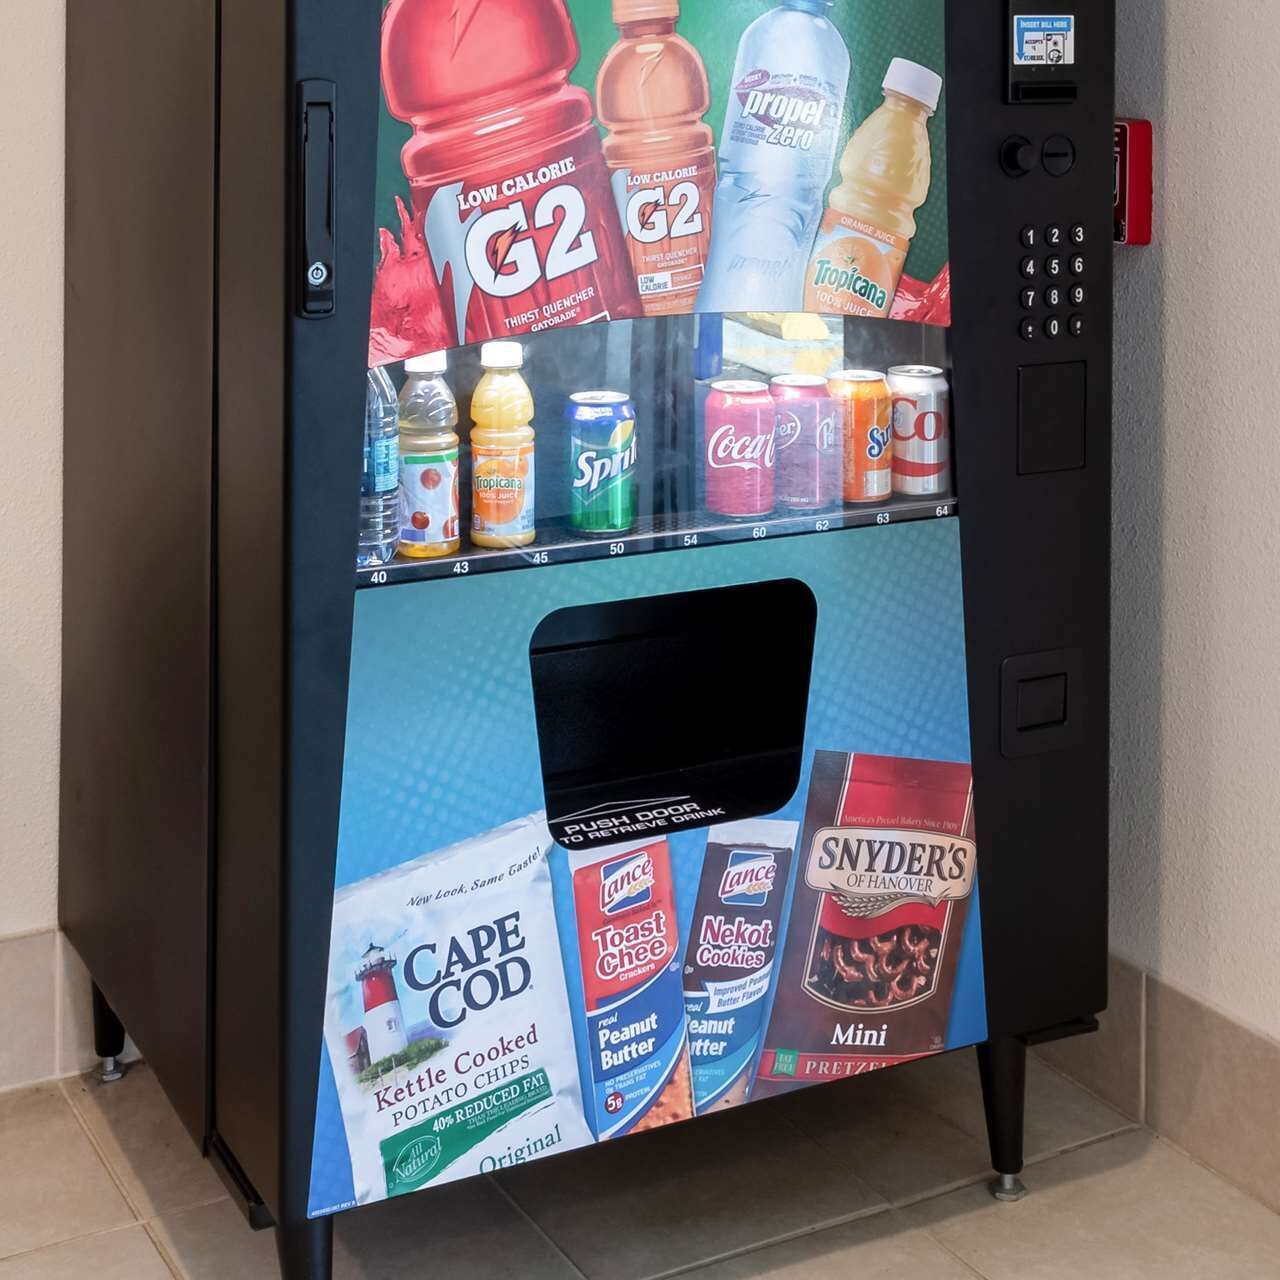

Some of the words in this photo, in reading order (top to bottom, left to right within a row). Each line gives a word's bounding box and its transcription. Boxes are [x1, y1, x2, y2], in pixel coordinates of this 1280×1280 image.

[742, 89, 826, 126] propel
[766, 124, 814, 151] zero
[457, 185, 499, 211] LOW
[501, 157, 576, 198] CALORIE
[627, 175, 651, 186] LOW
[652, 166, 698, 183] CALORIE
[626, 181, 704, 245] G2
[465, 184, 599, 298] G2
[840, 216, 874, 235] ORANGE
[874, 229, 897, 245] JUICE
[1027, 229, 1035, 245] 1
[1051, 228, 1060, 243] 2
[1075, 227, 1084, 242] 3
[641, 253, 664, 264] THIRST
[664, 247, 697, 261] QUENCHER
[1026, 259, 1035, 275] 4
[1051, 259, 1059, 274] 5
[1074, 257, 1083, 273] 6
[640, 275, 655, 284] LOW
[640, 281, 670, 293] CALORIE
[813, 259, 887, 310] Tropicana
[504, 308, 540, 329] THIRST
[542, 286, 596, 318] QUENCHER
[815, 290, 842, 309] 100%
[843, 299, 873, 317] JUICE
[1027, 291, 1035, 306] 7
[1051, 289, 1059, 305] 8
[1075, 287, 1084, 303] 9
[1050, 320, 1058, 335] 0
[476, 475, 522, 490] Tropicana
[877, 513, 890, 523] 63
[935, 506, 948, 516] 64
[753, 527, 766, 538] 60
[815, 520, 829, 531] 62
[610, 543, 624, 555] 50
[684, 534, 698, 545] 54
[453, 561, 469, 573] 43
[533, 552, 548, 564] 45
[370, 571, 387, 583] 40
[560, 833, 583, 844] TO
[588, 818, 668, 840] RETRIEVE
[671, 807, 726, 824] DRINK
[564, 815, 629, 835] PUSH
[634, 802, 700, 822] DOOR
[818, 836, 968, 882] SNYDER'S
[406, 893, 433, 907] New
[434, 883, 468, 901] Look,
[470, 872, 505, 891] Same
[601, 858, 651, 910] Lance
[720, 863, 776, 896] Lance
[846, 873, 867, 888] OF
[867, 874, 933, 893] HANOVER
[592, 910, 666, 953] Toast
[700, 915, 772, 948] Nekot
[403, 911, 526, 991] CAPE
[596, 939, 667, 980] Chee
[696, 943, 766, 969] Cookies
[619, 963, 656, 981] Crackers
[428, 956, 532, 1030] COD
[597, 1012, 618, 1029] real
[598, 1012, 658, 1050] Peanut
[830, 1023, 888, 1047] Mini
[600, 1037, 656, 1071] Butter
[774, 1062, 795, 1071] FREE
[779, 1054, 792, 1062] FAT
[374, 1067, 447, 1112] Kettle
[454, 1023, 539, 1075] Cooked
[604, 1077, 615, 1087] NO
[615, 1060, 662, 1084] PRESERVATIVES
[392, 1082, 468, 1127] POTATO
[473, 1054, 531, 1090] CHIPS
[614, 1077, 635, 1091] TRANS
[635, 1073, 647, 1083] FAT
[432, 1115, 455, 1133] 40%
[455, 1084, 521, 1123] REDUCED
[523, 1072, 546, 1093] FAT
[606, 1093, 623, 1111] 5g
[625, 1087, 651, 1101] PROTEIN
[395, 1136, 443, 1183] Natural
[408, 1142, 424, 1161] All
[479, 1123, 563, 1175] Original
